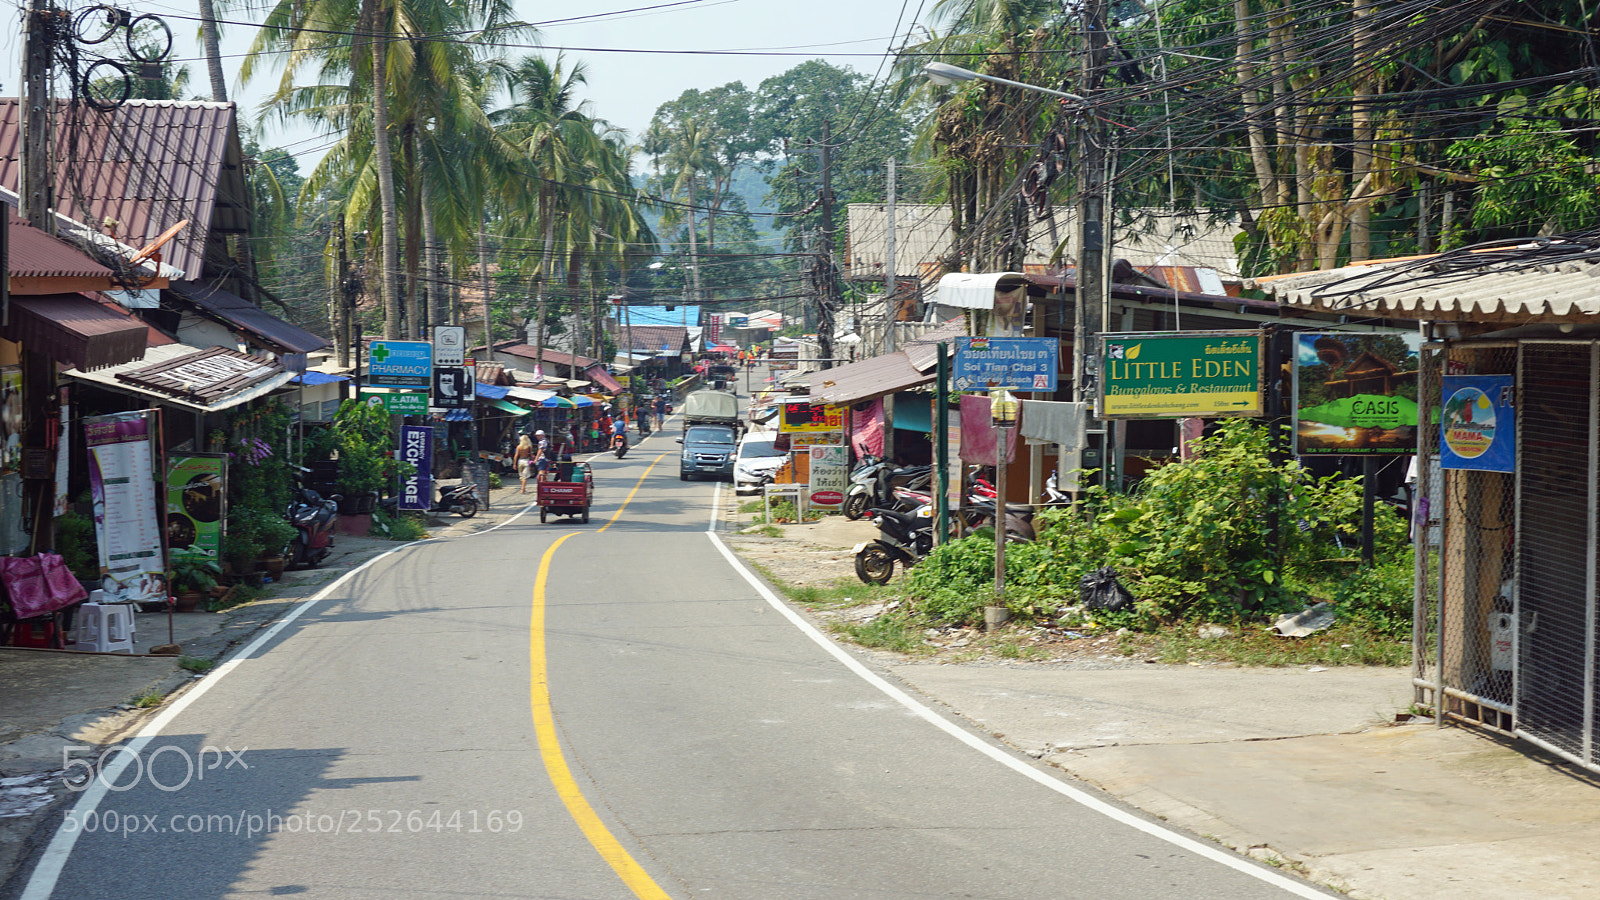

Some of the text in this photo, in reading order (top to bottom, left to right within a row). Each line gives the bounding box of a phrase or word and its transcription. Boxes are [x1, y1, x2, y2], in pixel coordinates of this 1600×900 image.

[371, 364, 429, 375] PHARMACY
[963, 362, 1048, 372] Soi Tian Chai 3
[1191, 358, 1251, 378] EDEN
[1006, 375, 1032, 383] Beach
[1111, 382, 1252, 399] Bungalows & Restaurant
[1453, 431, 1483, 441] MAMA
[405, 430, 420, 504] EXCHNGE
